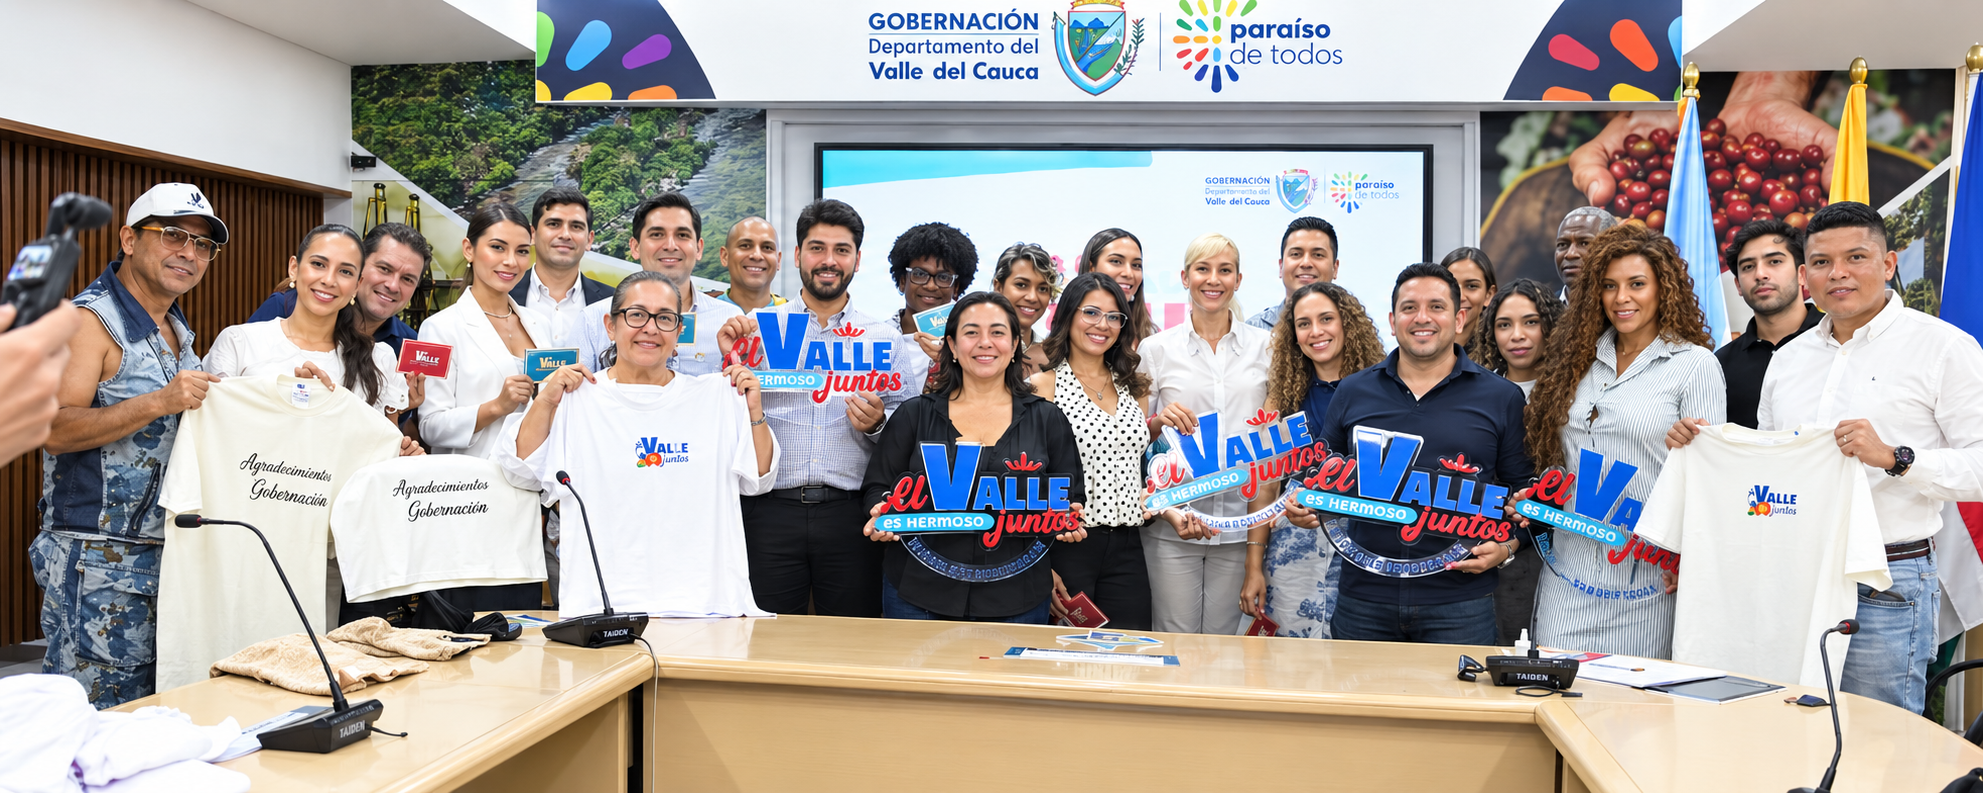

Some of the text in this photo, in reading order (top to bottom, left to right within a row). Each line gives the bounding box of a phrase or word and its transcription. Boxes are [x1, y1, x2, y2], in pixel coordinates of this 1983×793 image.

[868, 9, 1039, 31] GOBERNACIÓN
[1230, 17, 1332, 44] paraíso
[868, 37, 1039, 58] Departamento del
[1230, 43, 1343, 65] de todos
[868, 62, 1039, 81] Valle del Cauca
[1205, 175, 1271, 185] GOBERNACIÓN
[1258, 187, 1271, 195] del
[1205, 197, 1271, 206] Valle del Cauca
[1354, 190, 1400, 199] de todos
[756, 312, 892, 371] VALLE
[757, 369, 903, 404] ERMOSO juntos
[640, 436, 689, 454] VALLE
[1167, 411, 1314, 479] VALLE
[239, 452, 333, 483] Agradecimientos
[920, 443, 1071, 511] VALLE
[1170, 441, 1329, 502] HERMOSO juntos
[1356, 429, 1510, 520] VALLE
[249, 478, 329, 508] Gobernación
[392, 478, 490, 500] Agradecimientos
[1753, 484, 1798, 505] VALLE
[407, 500, 489, 523] Gobernación
[1328, 497, 1408, 521] HERMOSO
[1400, 505, 1513, 542] juntos
[906, 515, 985, 528] HERMOSO
[982, 507, 1081, 548] juntos
[1543, 511, 1617, 543] HERMOSO
[1516, 672, 1549, 681] TAIDEN
[339, 719, 366, 739] TAIDEN
